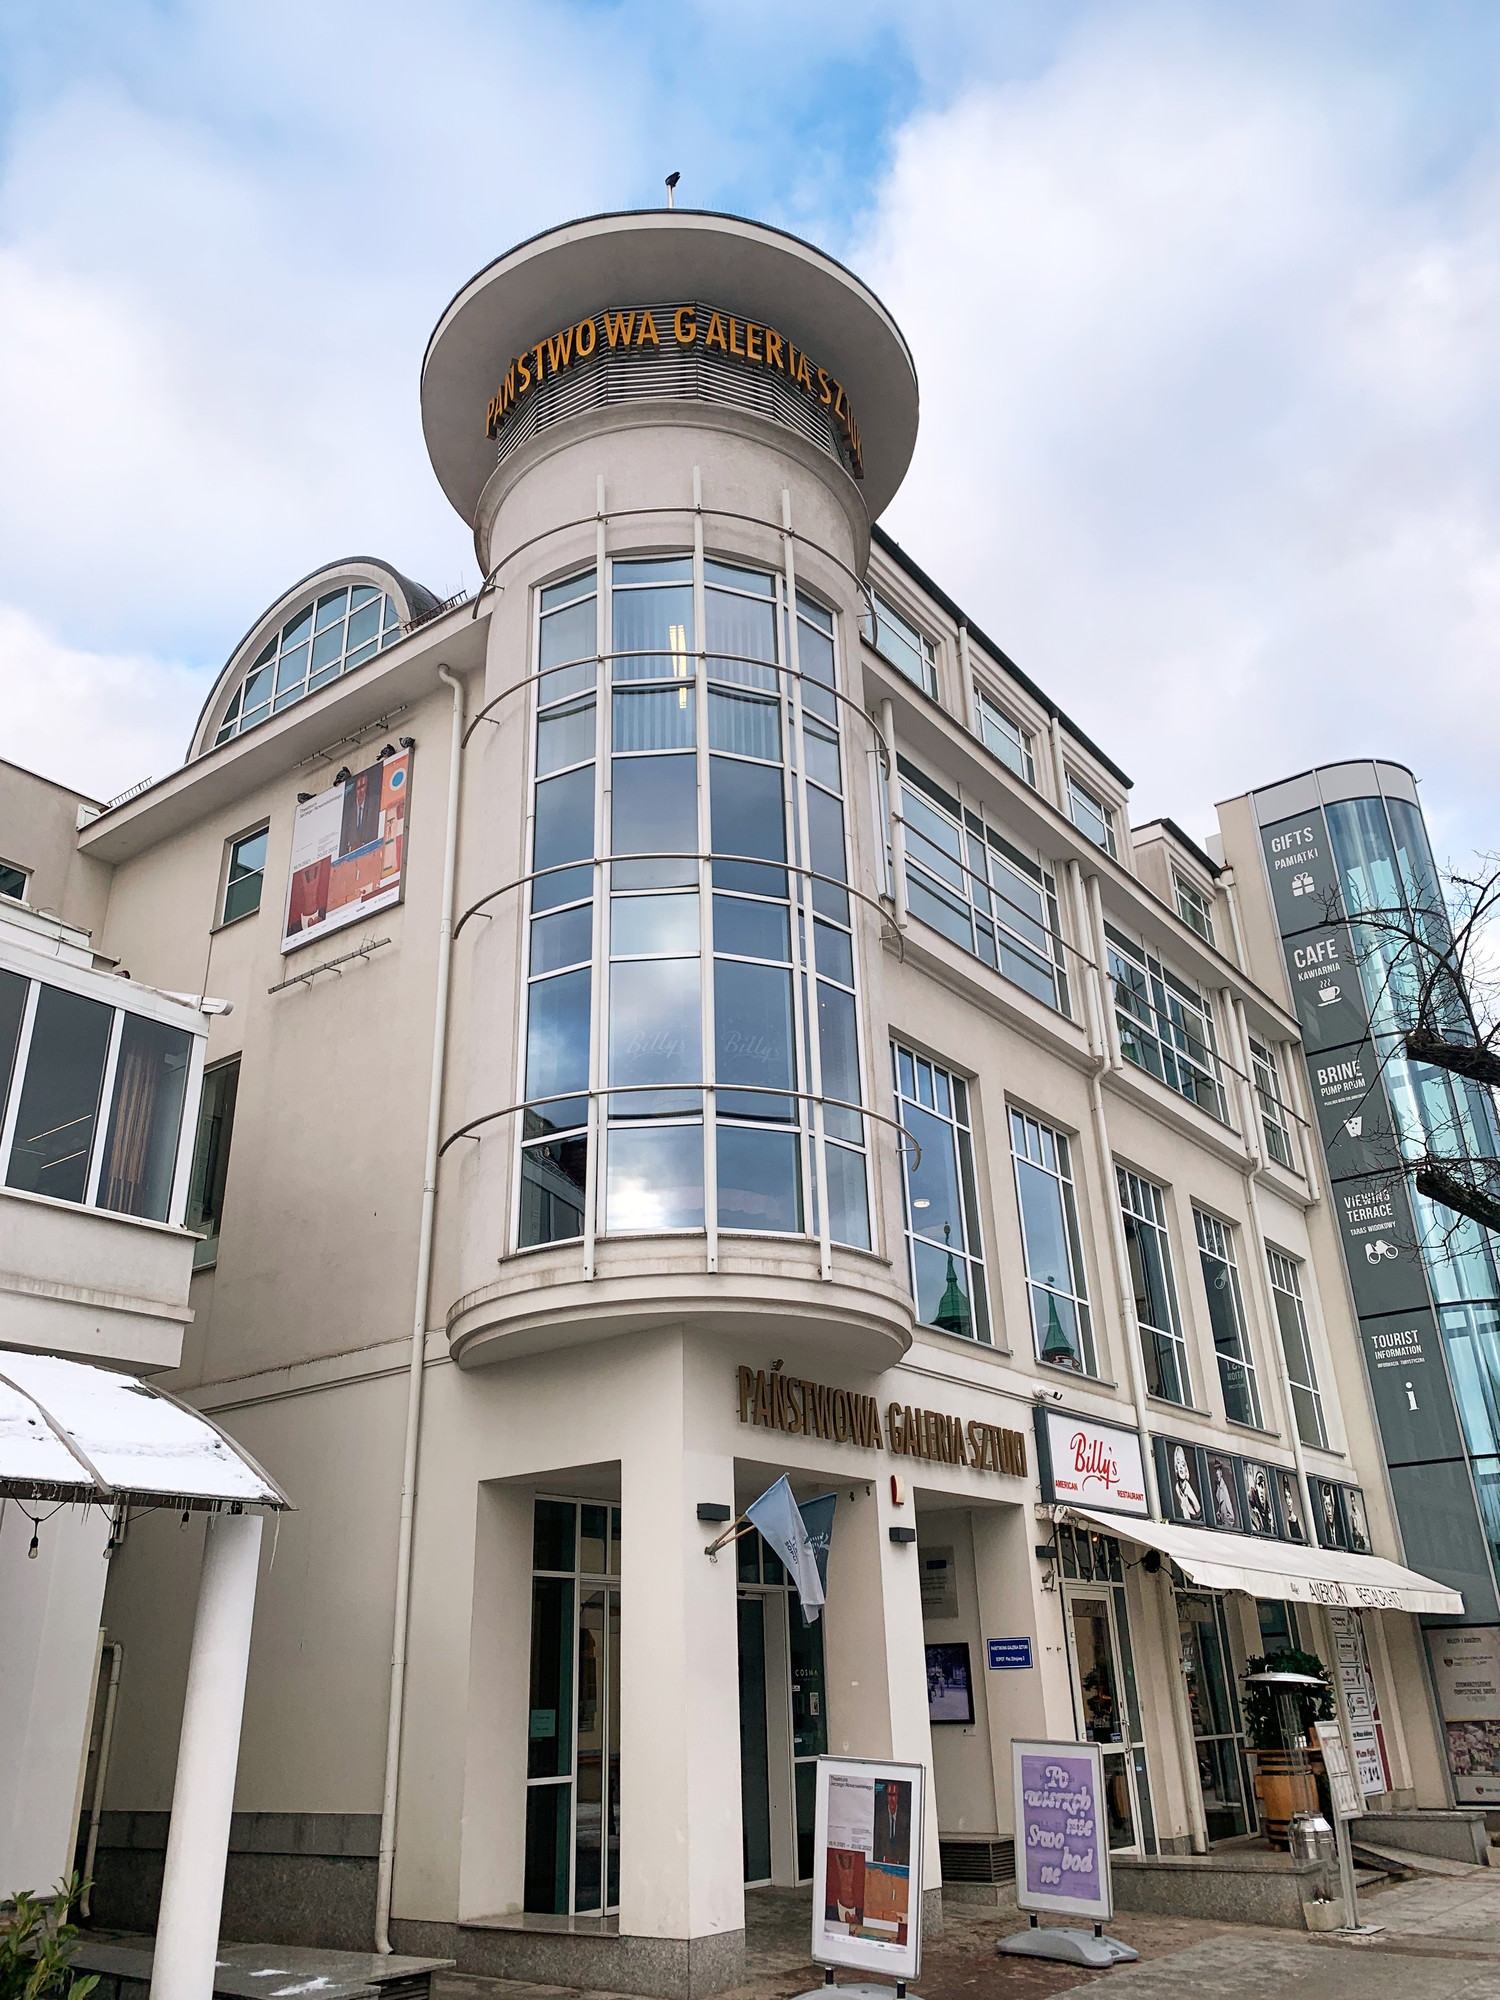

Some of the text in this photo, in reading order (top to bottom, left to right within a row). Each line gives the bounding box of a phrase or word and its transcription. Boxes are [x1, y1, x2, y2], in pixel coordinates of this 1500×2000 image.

[673, 307, 812, 393] GALERIA
[1271, 827, 1315, 853] GIFTS
[1274, 848, 1319, 870] PAMIĄTKI
[1294, 938, 1339, 969] CAFE
[1298, 962, 1341, 982] KAWIARNIA
[1317, 1060, 1363, 1086] BRINE
[1320, 1078, 1366, 1097] PUMP ROOM
[1343, 1189, 1390, 1209] VIEWING
[1346, 1203, 1394, 1223] TERRACE
[1350, 1220, 1396, 1236] TARAS WIDOKOWY
[1371, 1329, 1418, 1349] TOURIST
[1374, 1345, 1422, 1360] INFORMATION
[738, 1359, 1029, 1478] PAŃSTWOWA GALERIA SZTUKI
[1070, 1432, 1120, 1491] Billy's
[1055, 1480, 1145, 1502] AMERICAN RESTAURANT
[1308, 1580, 1349, 1605] AMERICAN
[794, 1668, 819, 1677] COSMA
[1061, 1846, 1093, 1873] bod
